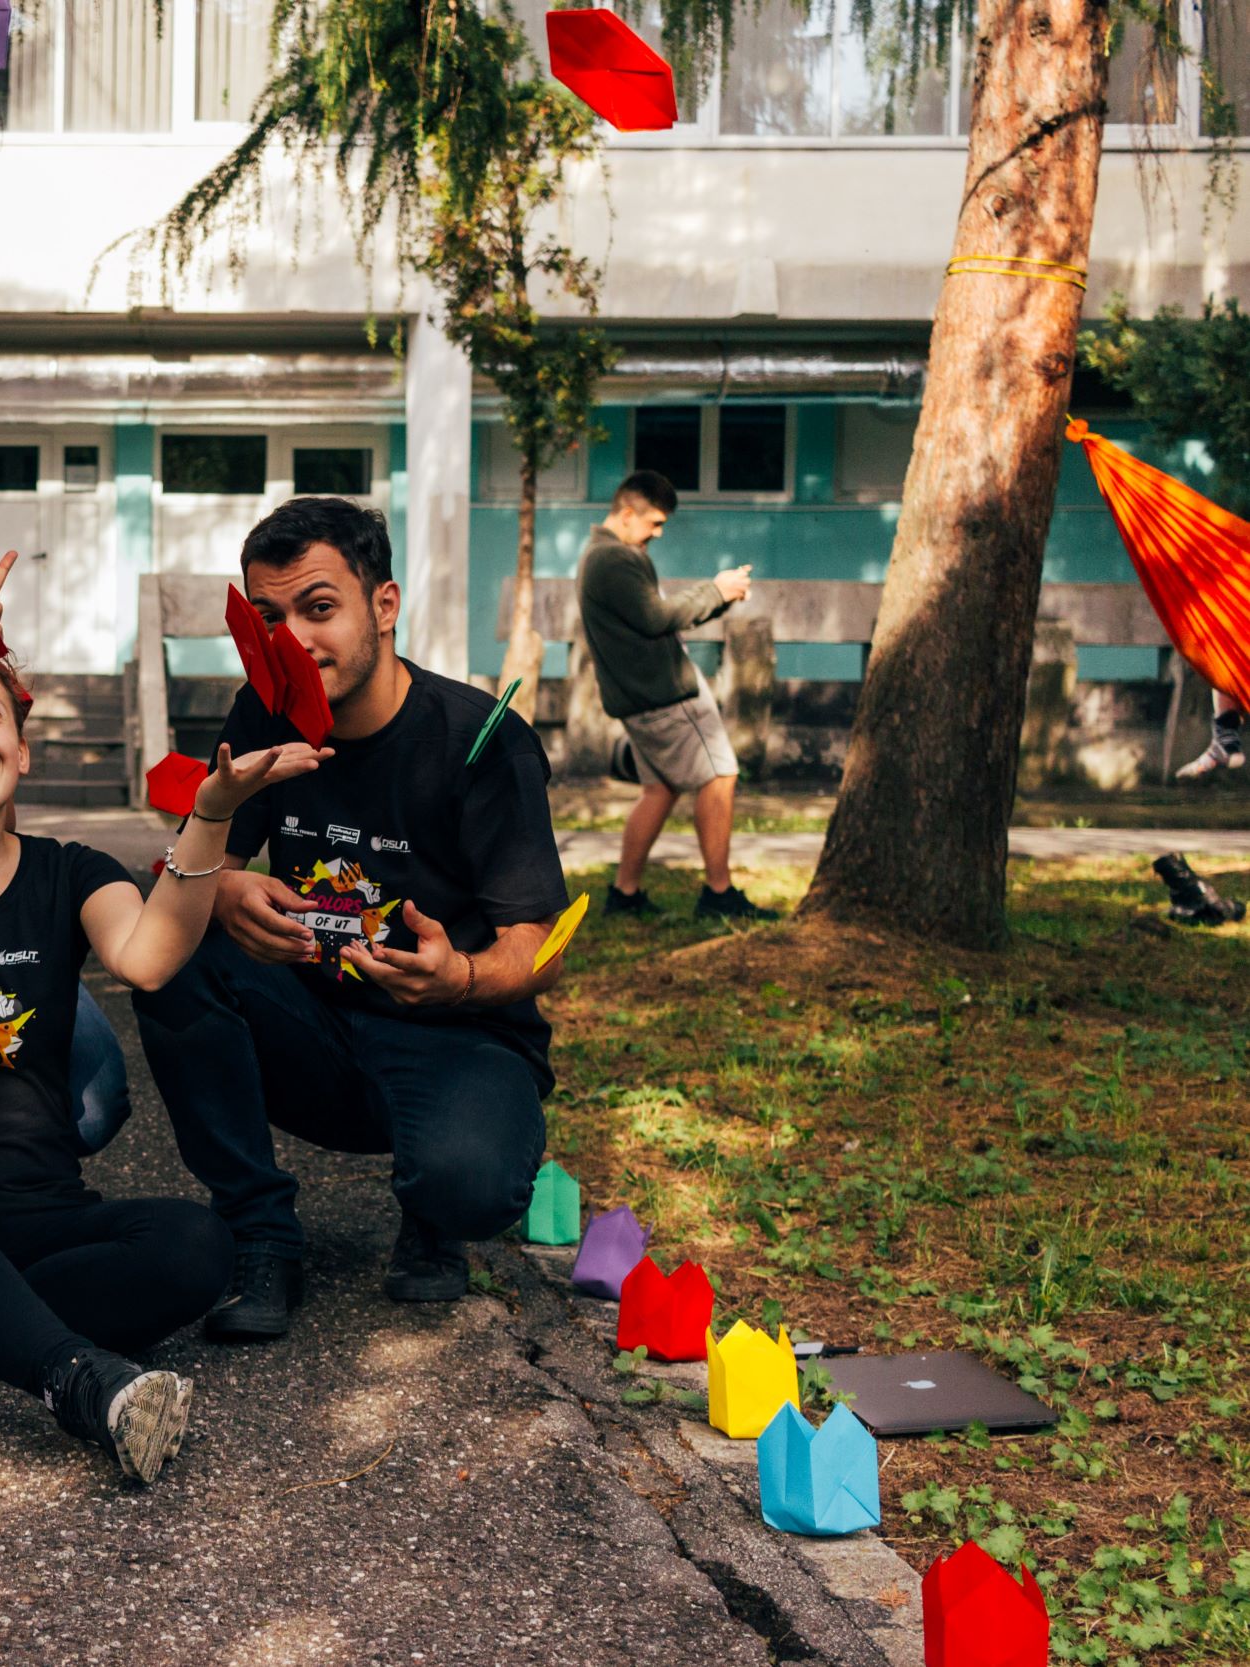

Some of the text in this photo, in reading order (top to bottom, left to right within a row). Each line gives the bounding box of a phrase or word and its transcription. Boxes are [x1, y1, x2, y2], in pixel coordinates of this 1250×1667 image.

[315, 916, 351, 930] OF UT
[5, 950, 39, 962] OSUT
